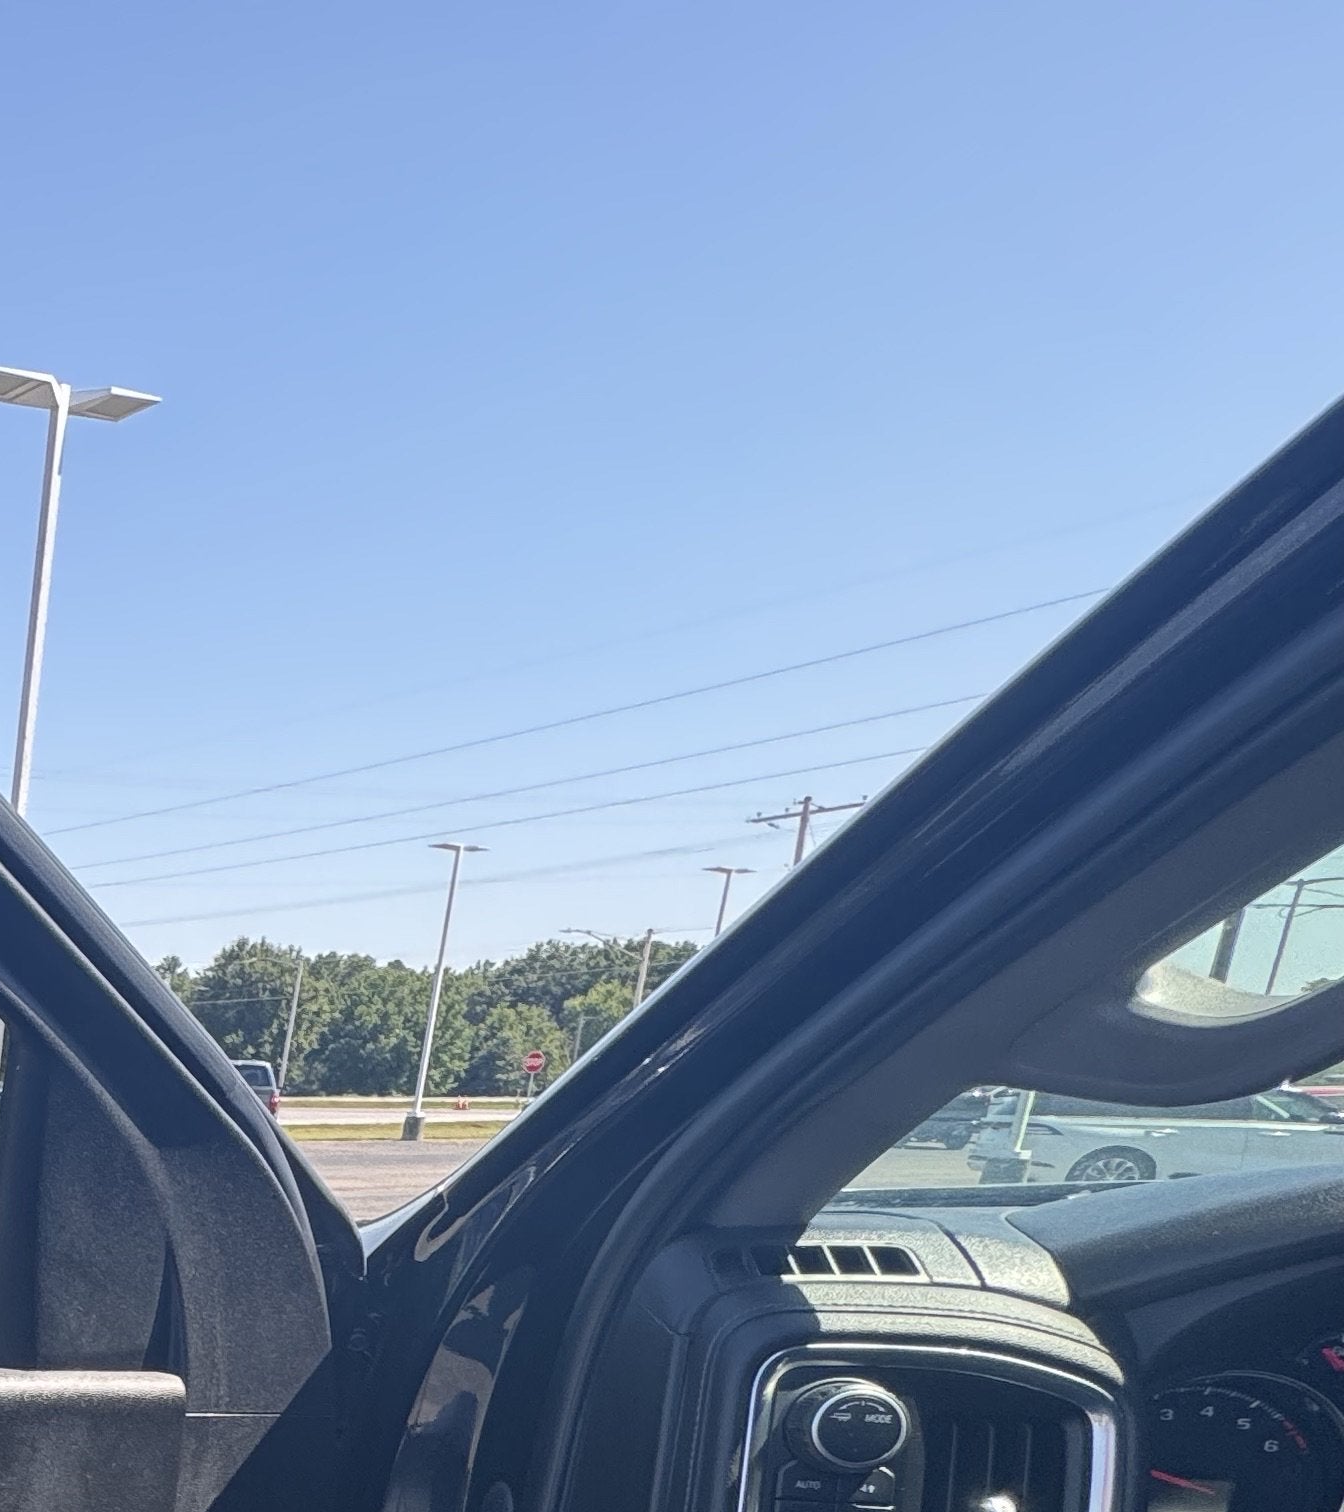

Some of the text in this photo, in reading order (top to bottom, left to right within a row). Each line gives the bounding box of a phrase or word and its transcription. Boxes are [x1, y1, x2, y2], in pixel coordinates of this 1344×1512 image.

[1160, 1408, 1174, 1421] 3
[1200, 1405, 1213, 1417] 4
[864, 1414, 893, 1424] MODE
[1237, 1418, 1251, 1430] 5
[1264, 1440, 1279, 1452] 6
[795, 1480, 821, 1490] AUTO
